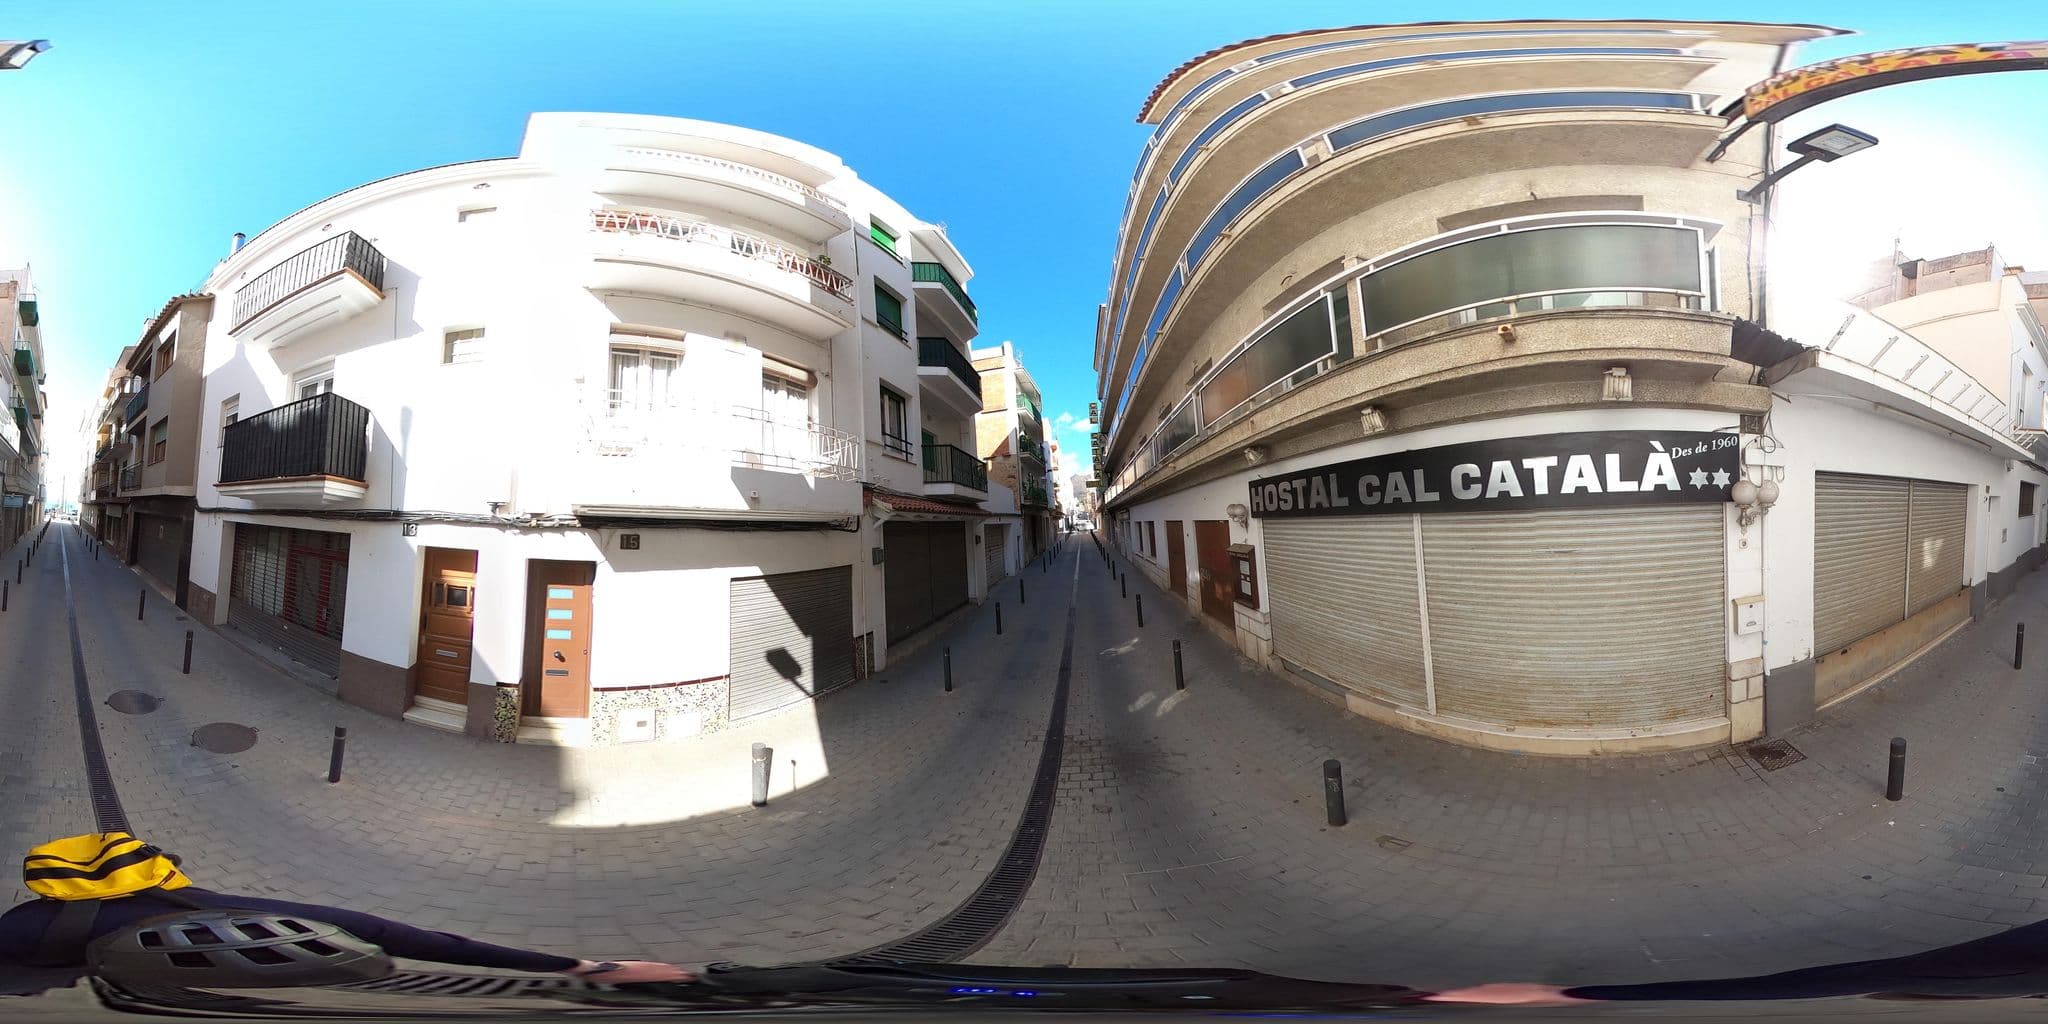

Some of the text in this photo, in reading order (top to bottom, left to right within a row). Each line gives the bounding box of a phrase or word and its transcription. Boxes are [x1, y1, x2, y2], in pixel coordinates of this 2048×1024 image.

[1672, 436, 1738, 459] Des de 1960
[1251, 441, 1681, 512] HOSTAL CAL CATALÀ
[403, 523, 418, 536] 13
[622, 535, 638, 550] 15
